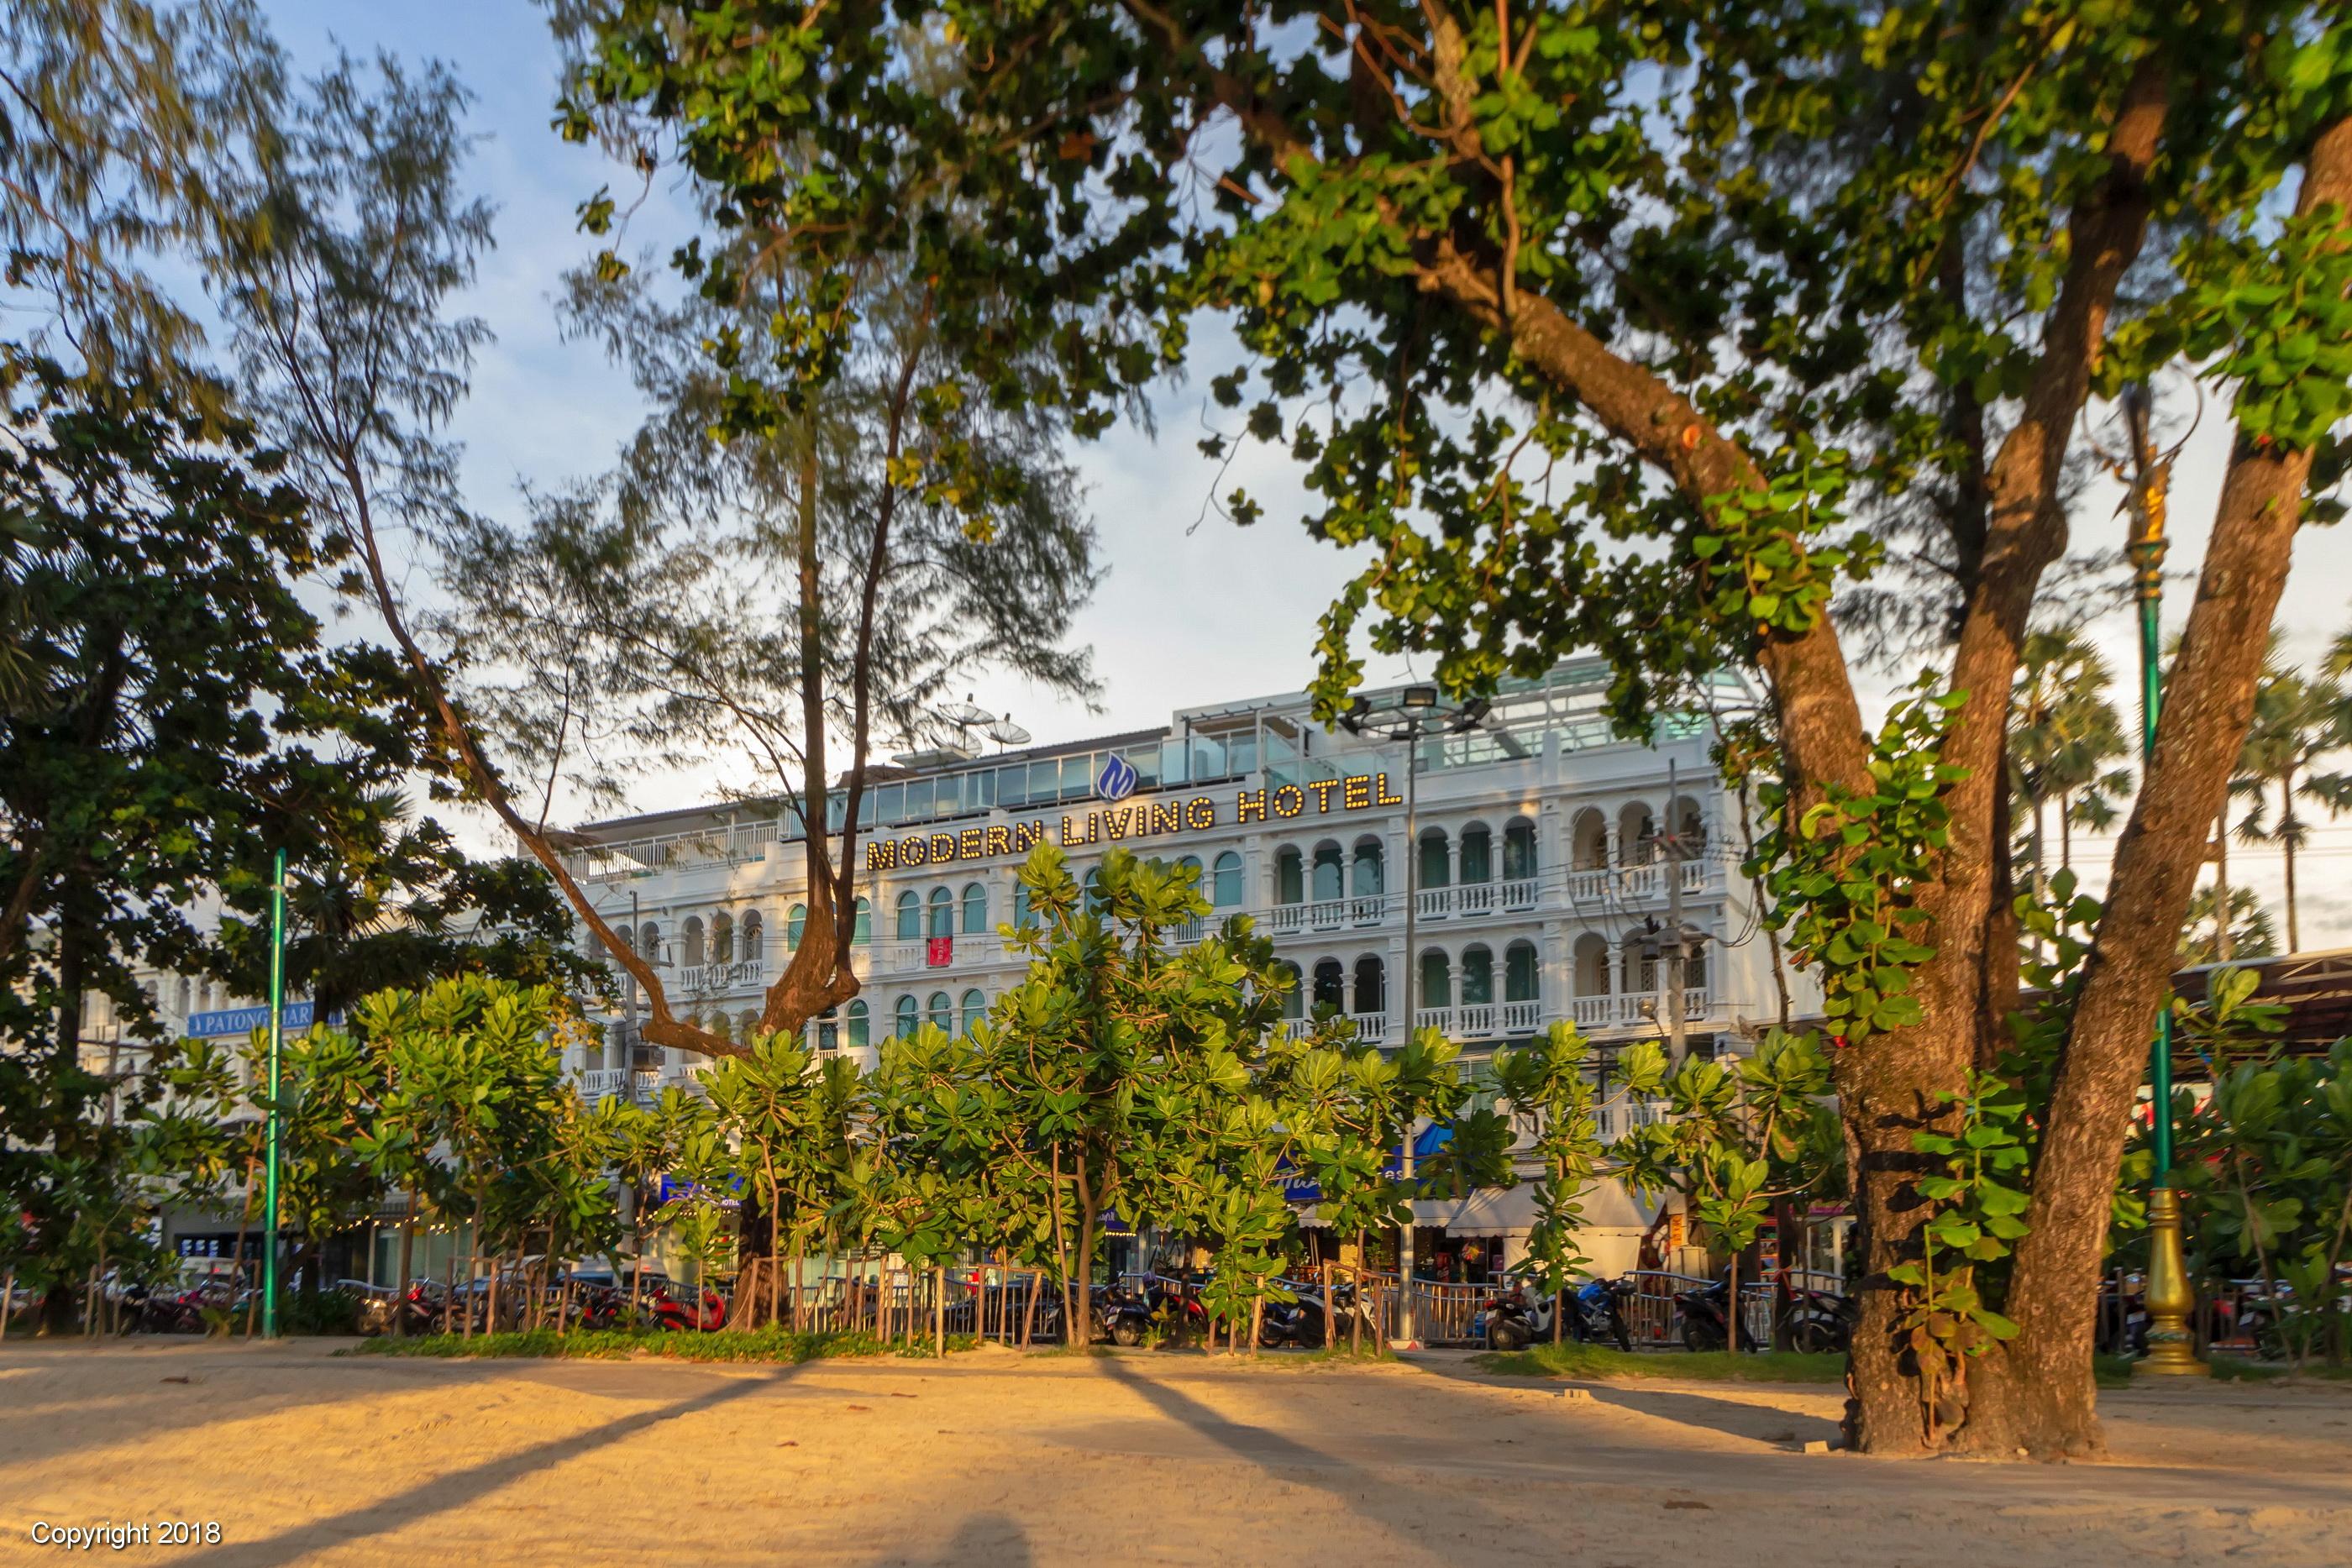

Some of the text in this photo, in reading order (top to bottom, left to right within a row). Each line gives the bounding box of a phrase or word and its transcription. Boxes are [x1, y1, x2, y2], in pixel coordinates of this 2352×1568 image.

[867, 773, 1402, 871] MODERN LIVING HOTEL
[206, 1009, 269, 1033] PATONG
